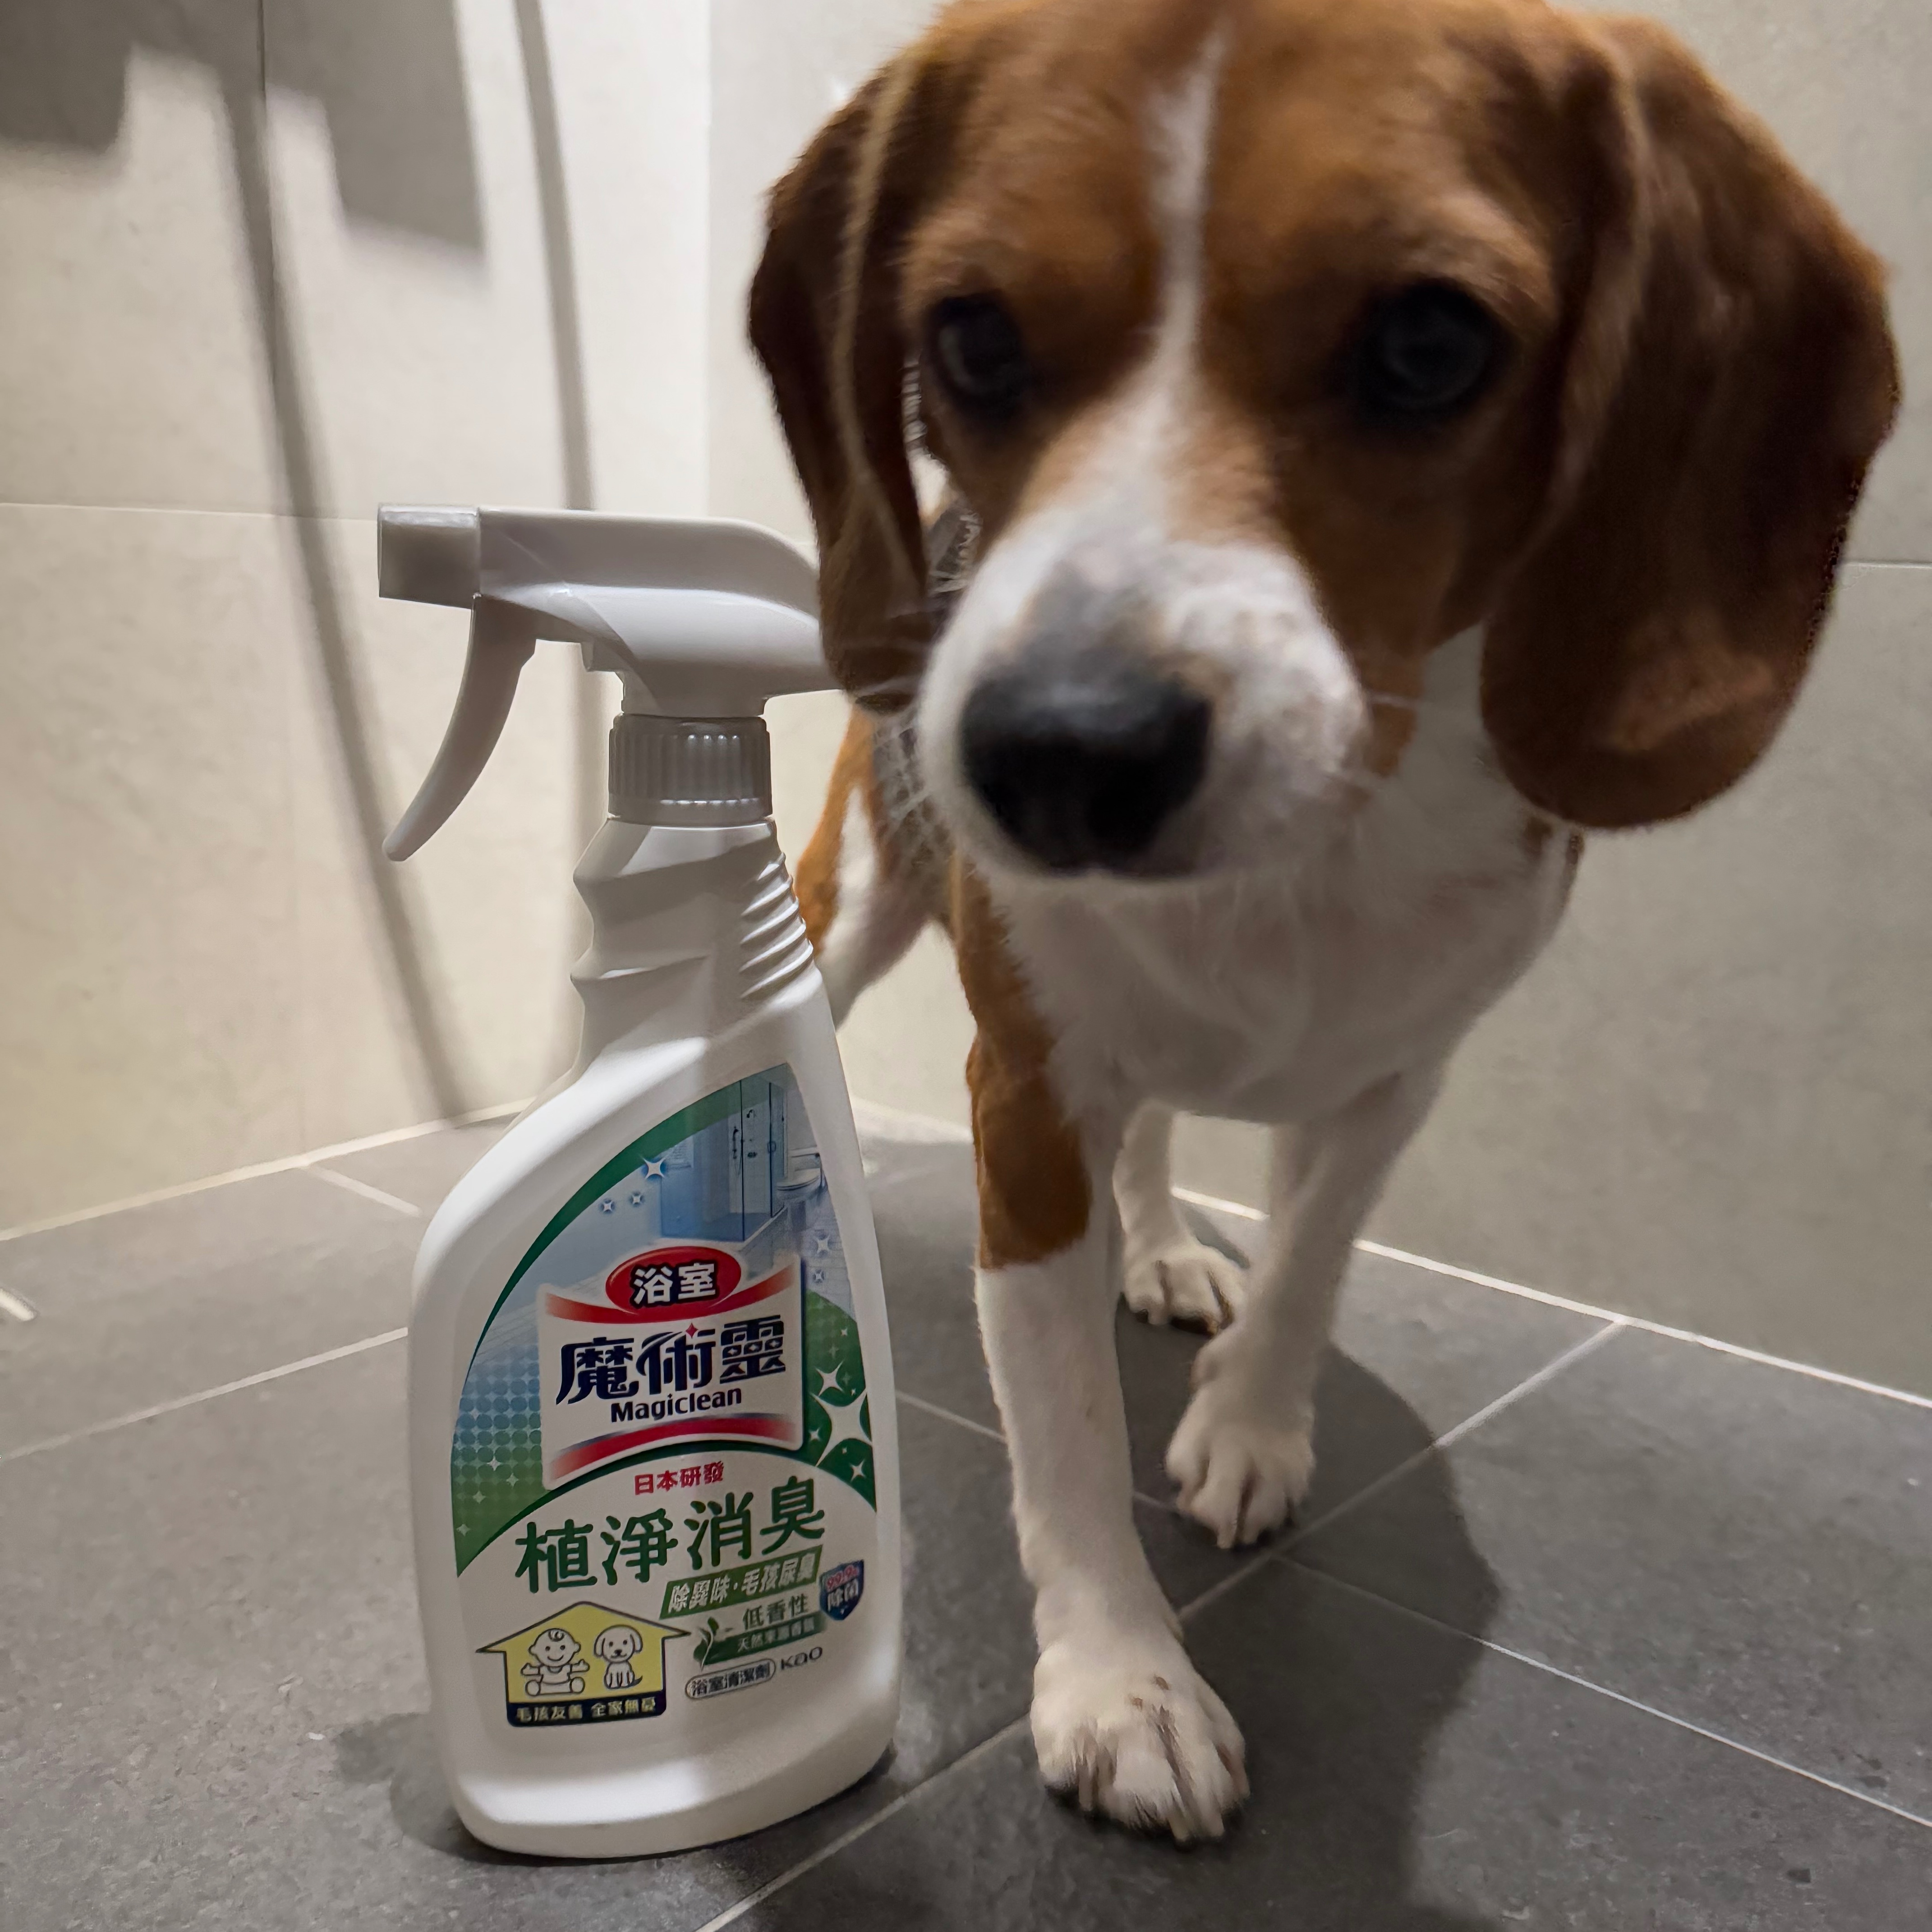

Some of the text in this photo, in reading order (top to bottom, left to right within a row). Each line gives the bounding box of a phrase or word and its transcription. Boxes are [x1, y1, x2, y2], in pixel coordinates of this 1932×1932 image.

[634, 1262, 716, 1305] 浴室
[556, 1314, 786, 1405] 魔術靈
[611, 1387, 742, 1423] Magiclean
[635, 1461, 724, 1495] 日本研發
[515, 1476, 825, 1593] 植淨消臭
[743, 1593, 808, 1630] 低香性
